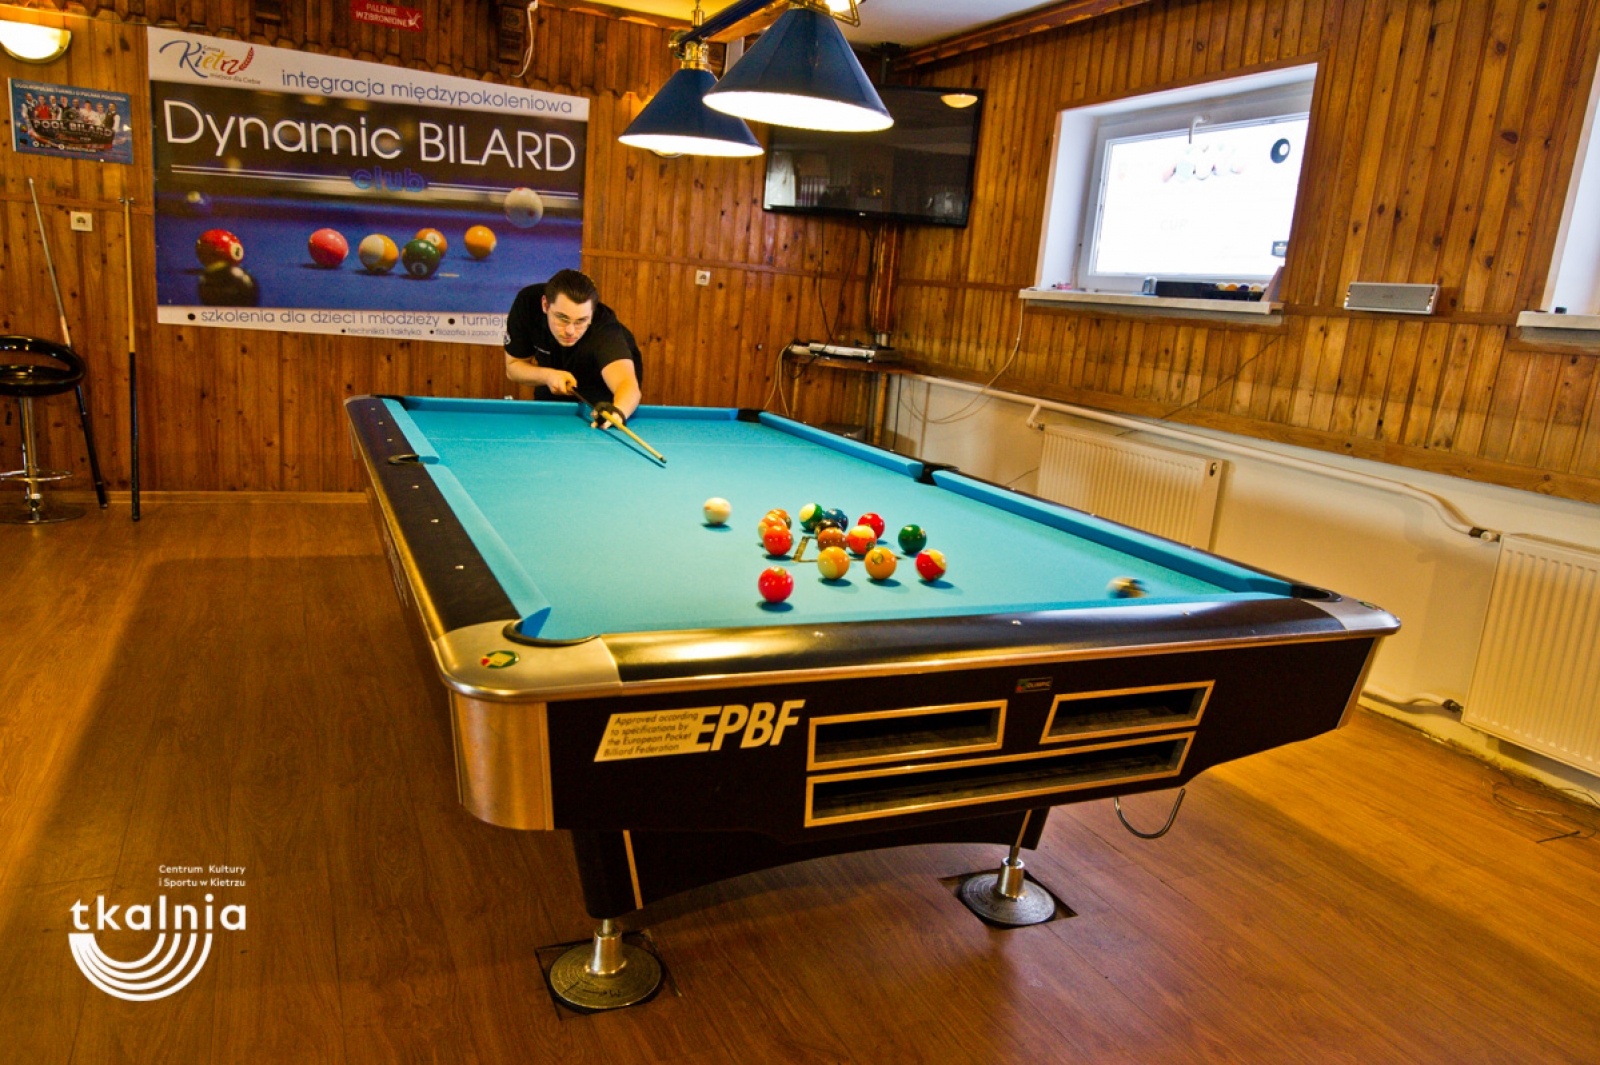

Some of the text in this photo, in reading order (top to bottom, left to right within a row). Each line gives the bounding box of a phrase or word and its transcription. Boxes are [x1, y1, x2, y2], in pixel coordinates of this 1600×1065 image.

[366, 3, 397, 15] PALENIE
[355, 10, 407, 27] WZBRONIONE
[159, 40, 240, 78] Kietrz
[282, 70, 572, 114] integracja międzypokoleniowa
[34, 120, 113, 137] POOL BILARD
[164, 99, 577, 172] Dynamic BILARD
[352, 166, 426, 192] club
[201, 309, 275, 323] szkolenia
[280, 310, 305, 323] dla
[311, 310, 356, 324] dzieci
[368, 312, 440, 327] młodzieży
[347, 327, 385, 335] technika
[391, 328, 422, 336] taktyka
[614, 712, 699, 725] Approved according
[695, 699, 806, 752] EPBF
[622, 725, 676, 735] specifications
[678, 723, 689, 731] by
[607, 732, 692, 745] the European Pocket
[603, 744, 680, 757] Billiard Federation
